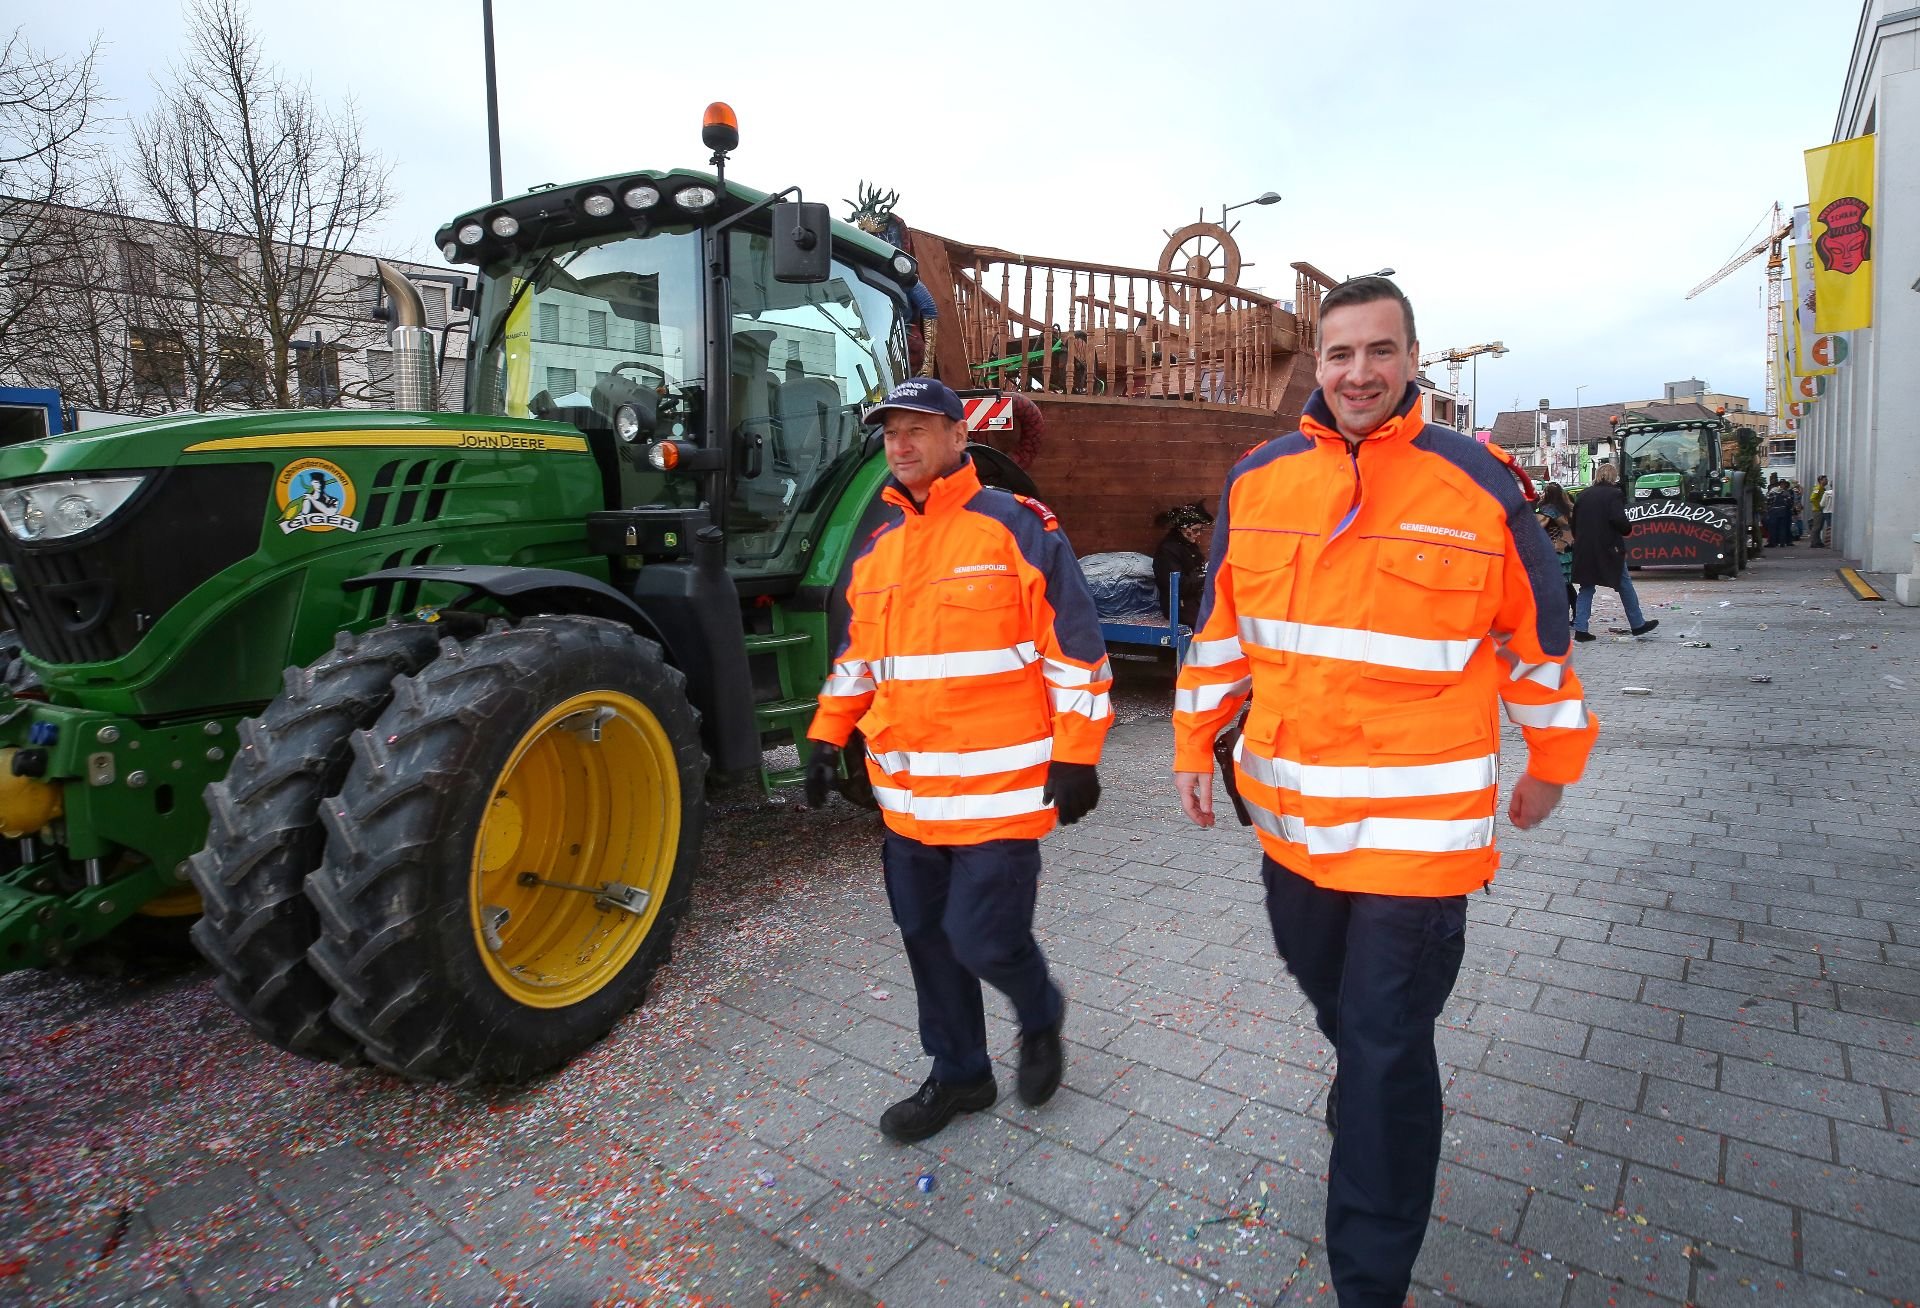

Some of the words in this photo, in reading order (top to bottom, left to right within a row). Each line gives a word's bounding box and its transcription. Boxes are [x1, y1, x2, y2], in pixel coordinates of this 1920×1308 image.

[458, 434, 498, 447] JOHN
[500, 435, 546, 449] DEERE
[287, 515, 354, 530] GIGER
[1399, 522, 1477, 541] GEMEINDEPOLIZEI
[1625, 546, 1698, 560] CHAAN
[953, 564, 1008, 575] GEMEINDEPOLIZEI
